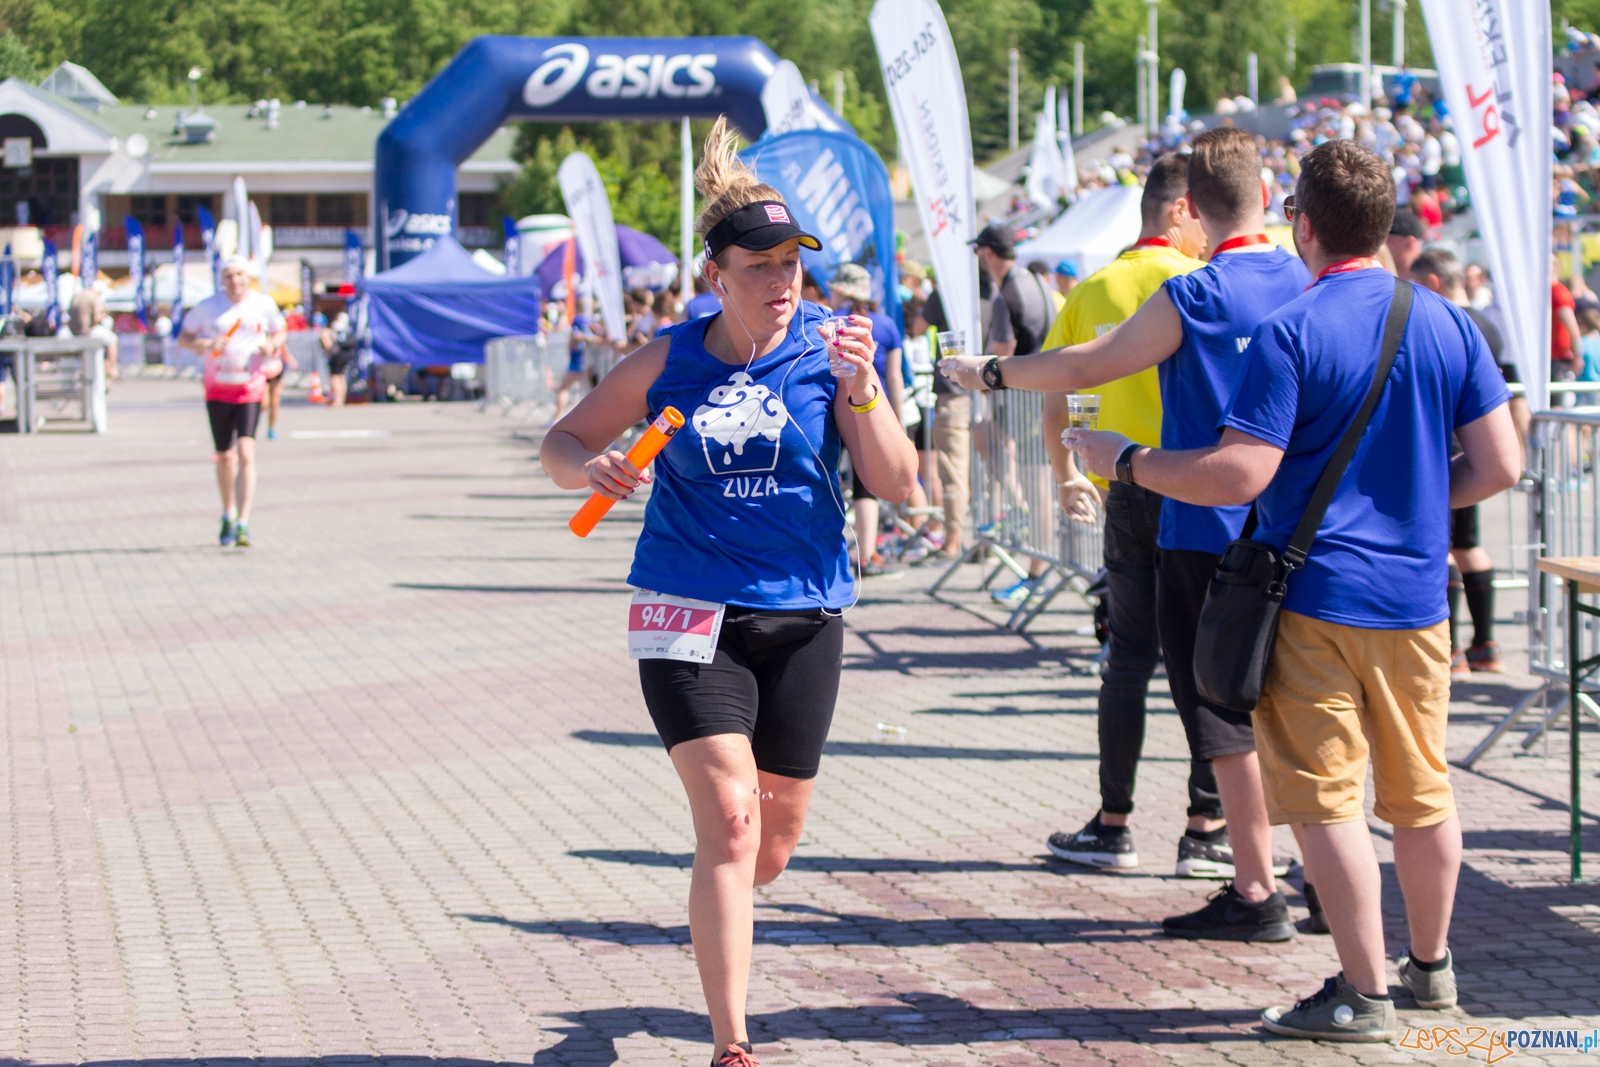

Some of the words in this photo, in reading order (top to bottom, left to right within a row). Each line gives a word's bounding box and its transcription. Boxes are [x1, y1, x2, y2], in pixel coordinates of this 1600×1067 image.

[586, 53, 718, 99] asics
[723, 475, 779, 499] ZUZA
[641, 605, 693, 630] 94/1
